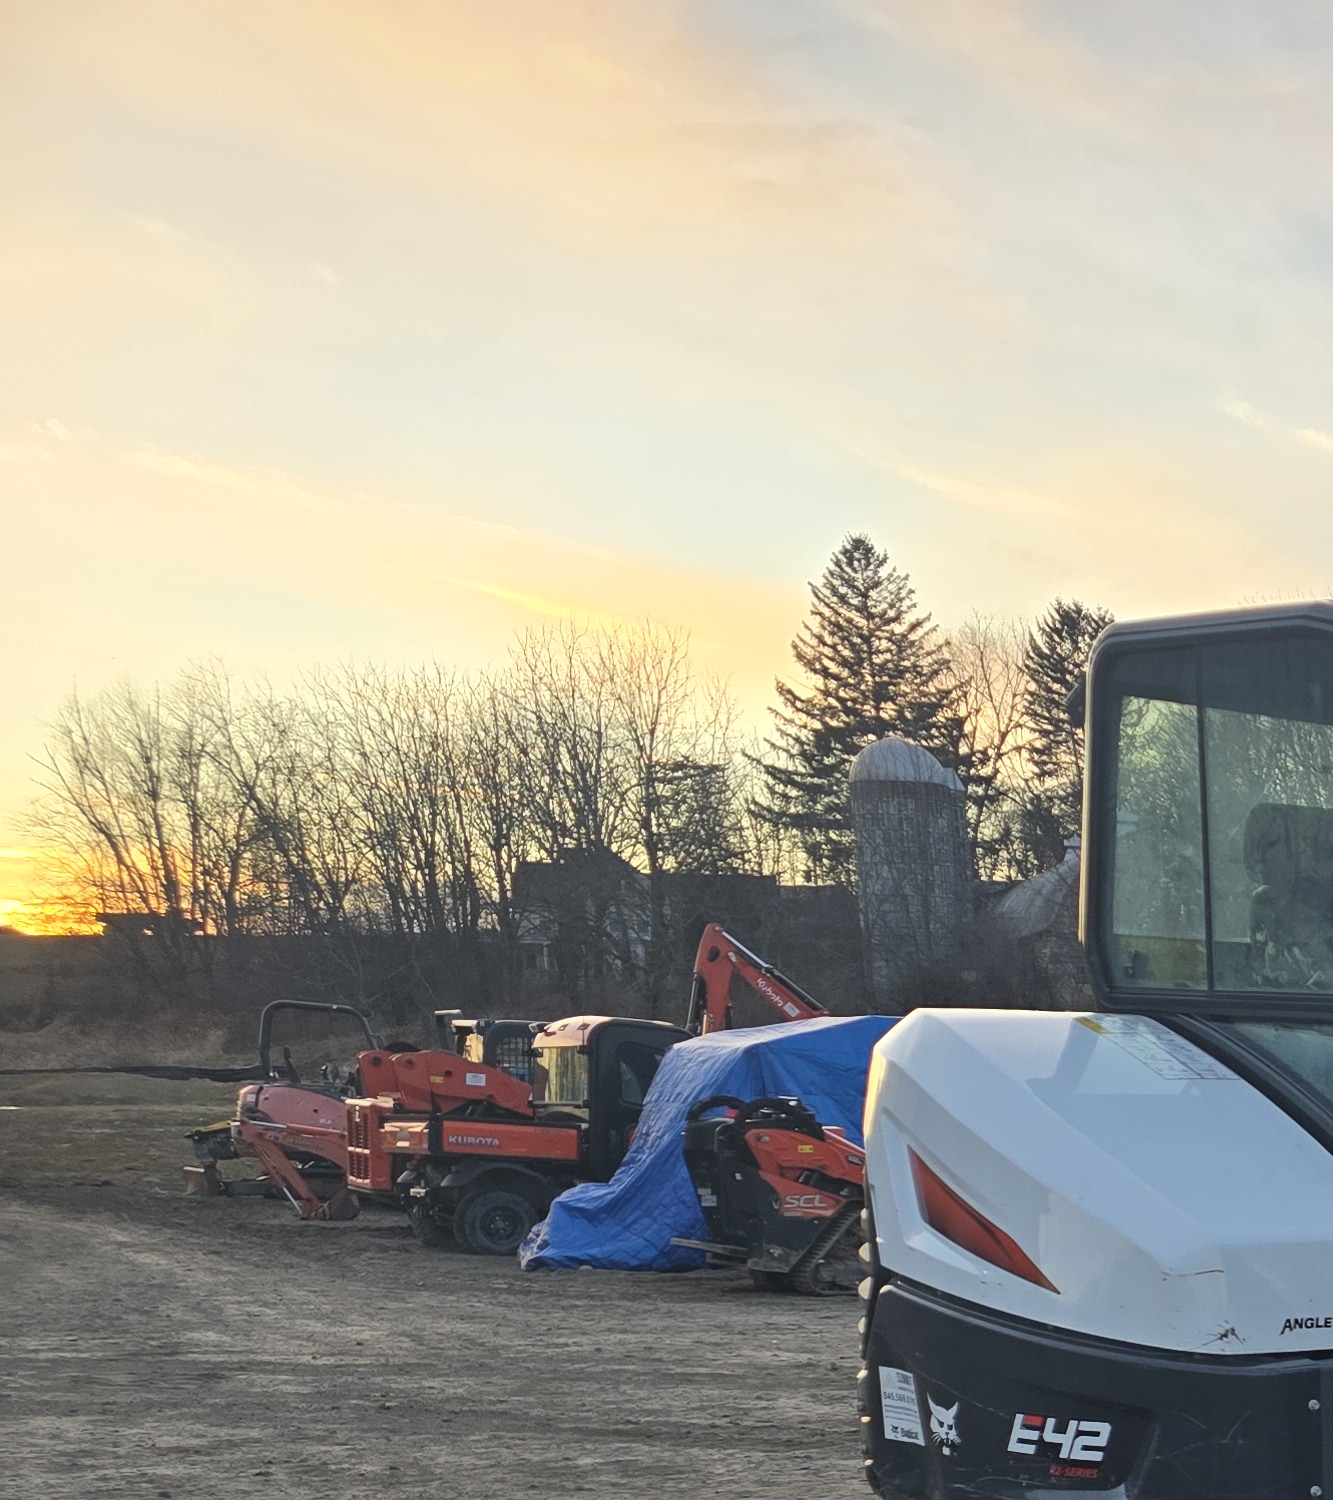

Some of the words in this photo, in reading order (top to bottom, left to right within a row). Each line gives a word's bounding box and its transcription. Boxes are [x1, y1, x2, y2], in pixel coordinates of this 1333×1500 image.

[757, 978, 784, 1007] Kubota
[448, 1135, 500, 1147] KUBOTA
[783, 1194, 827, 1208] SCL
[1007, 1413, 1112, 1461] E42
